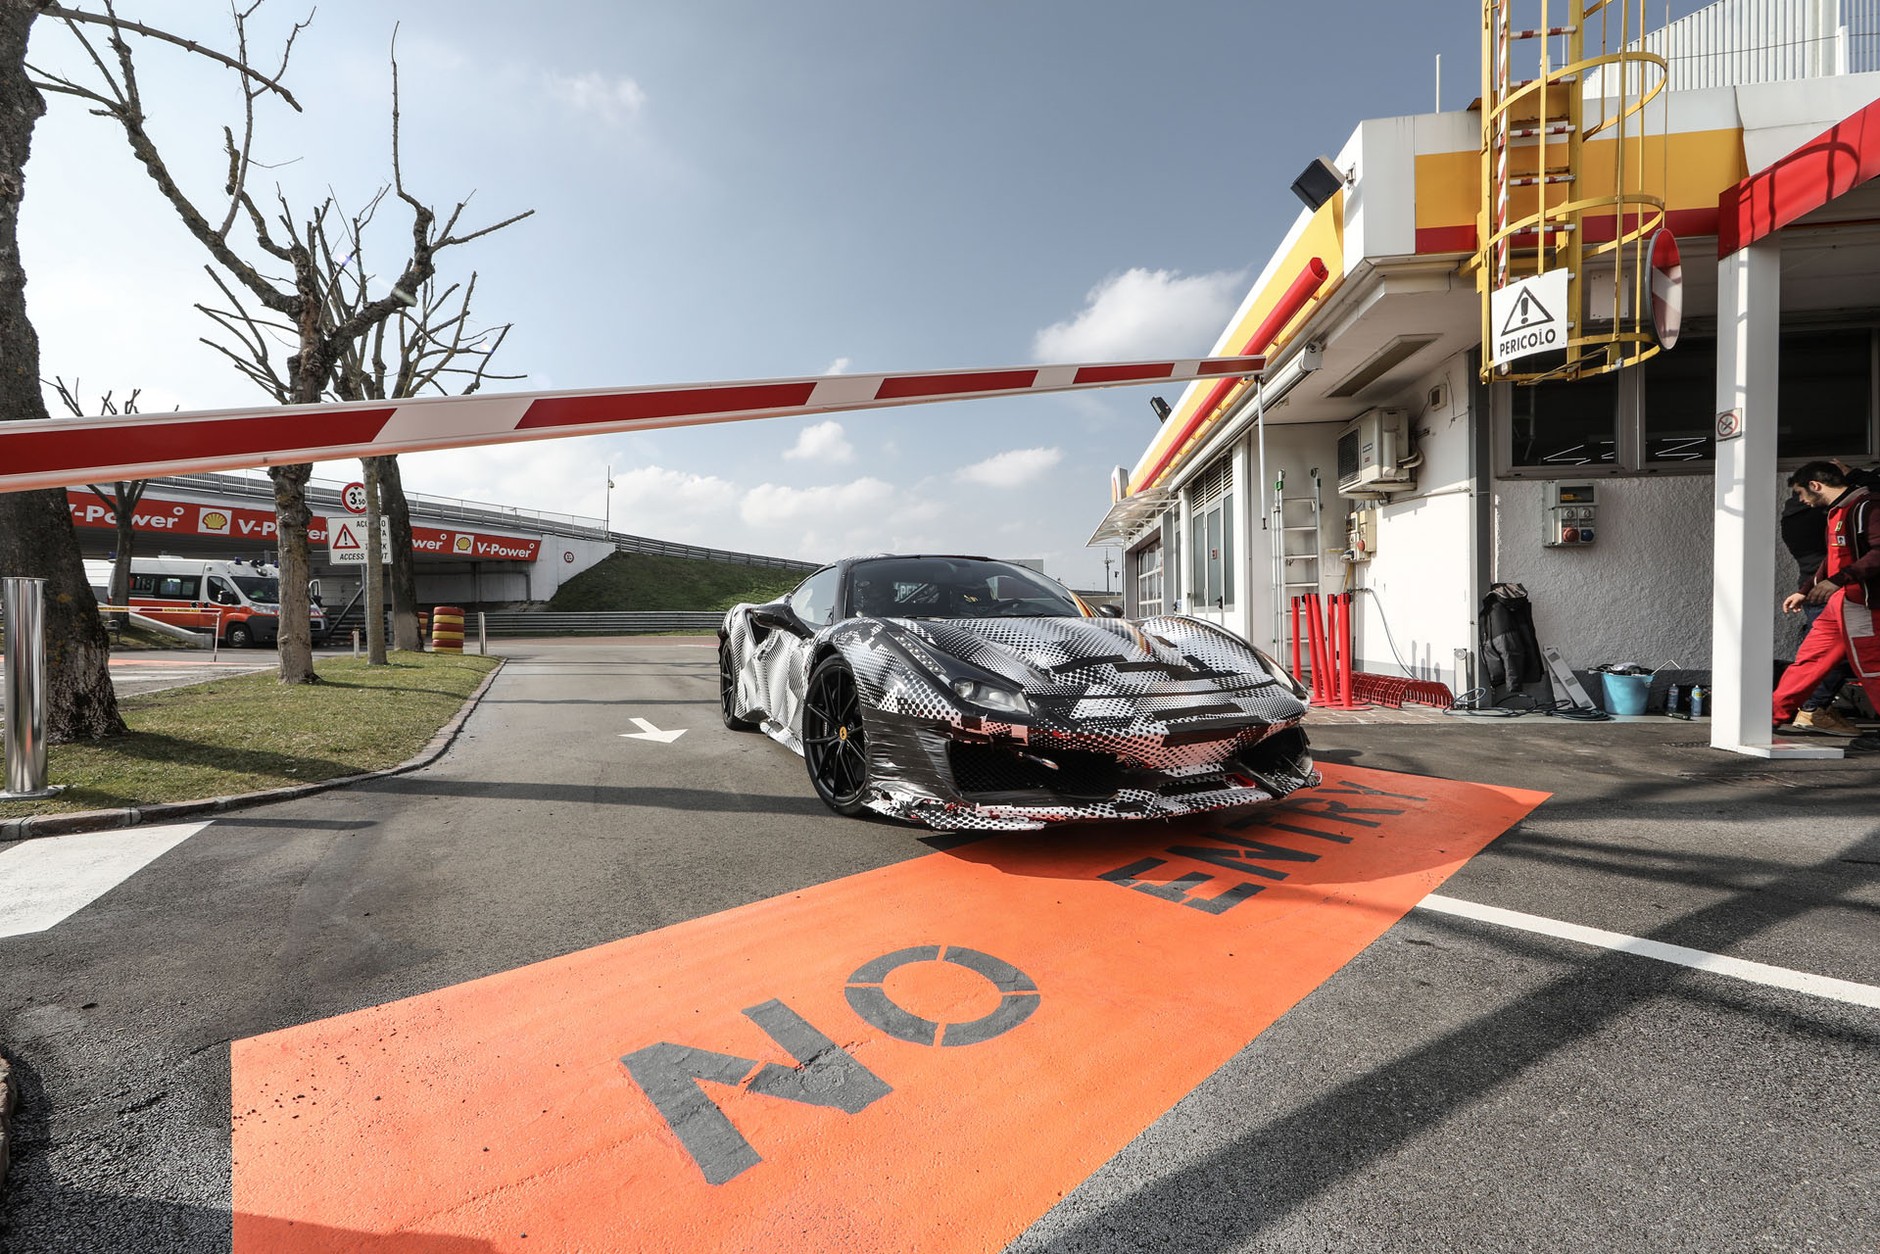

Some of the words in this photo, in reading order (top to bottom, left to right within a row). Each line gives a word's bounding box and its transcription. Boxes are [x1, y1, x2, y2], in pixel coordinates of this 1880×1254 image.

[1499, 328, 1556, 357] PERICOLO
[340, 552, 365, 561] ACCESS
[477, 542, 531, 558] V-Power
[619, 944, 1042, 1187] NO
[1096, 779, 1428, 915] ENTRY
